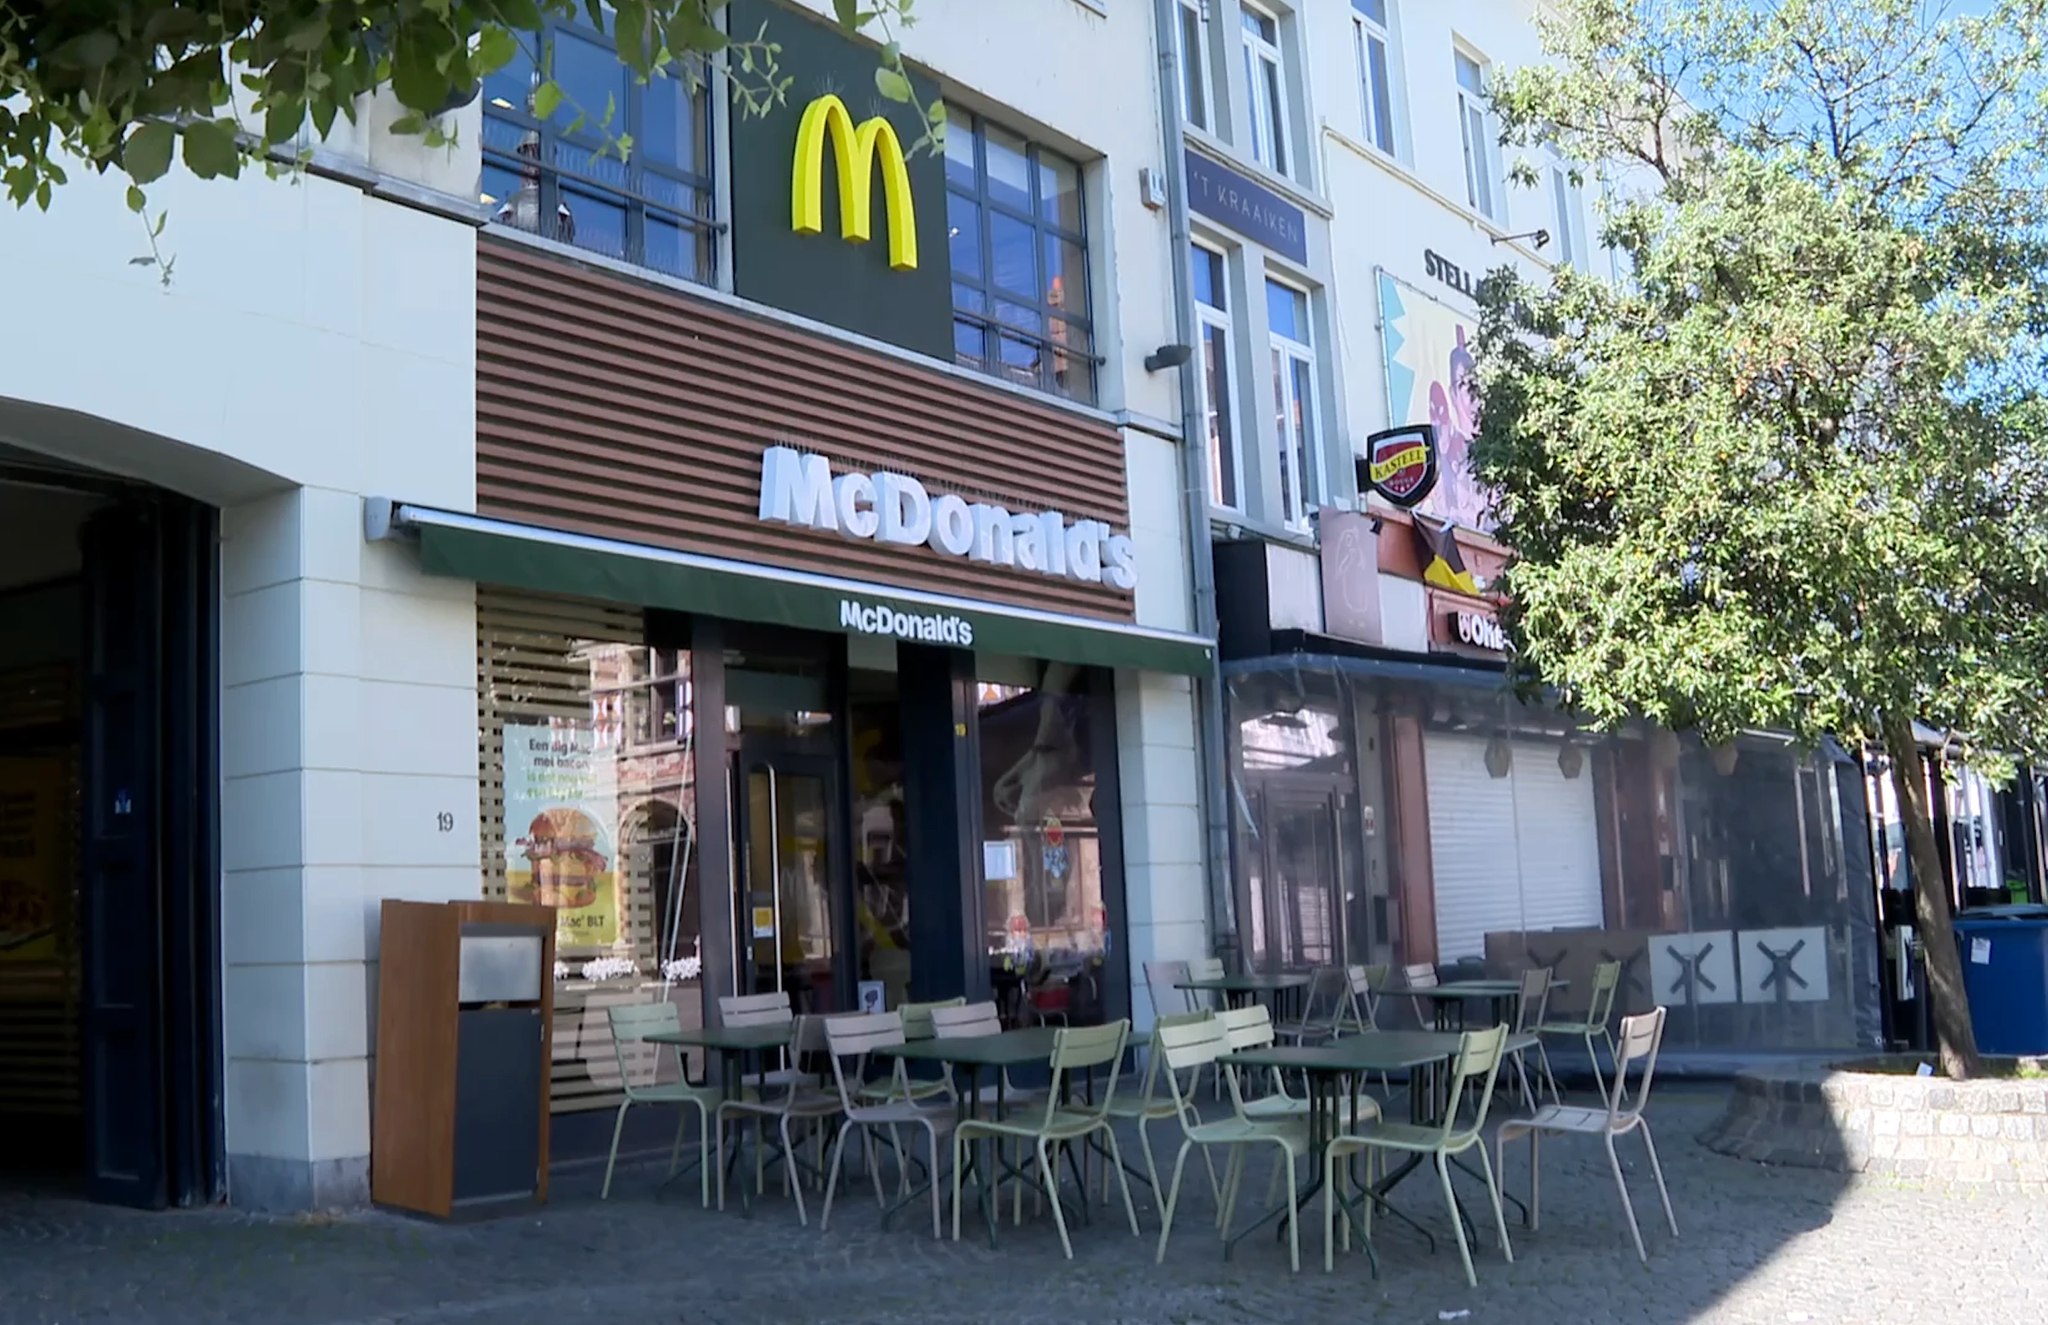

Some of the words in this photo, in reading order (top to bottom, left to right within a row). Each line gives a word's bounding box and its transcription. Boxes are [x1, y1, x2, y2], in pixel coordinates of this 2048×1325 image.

[1218, 185, 1298, 243] KRAAIKEN
[1374, 448, 1424, 480] KASTEEL
[759, 446, 1138, 590] McDonald's
[840, 599, 974, 646] McDonald's
[529, 738, 549, 751] Een
[436, 811, 454, 832] 19
[588, 915, 605, 927] BLT
